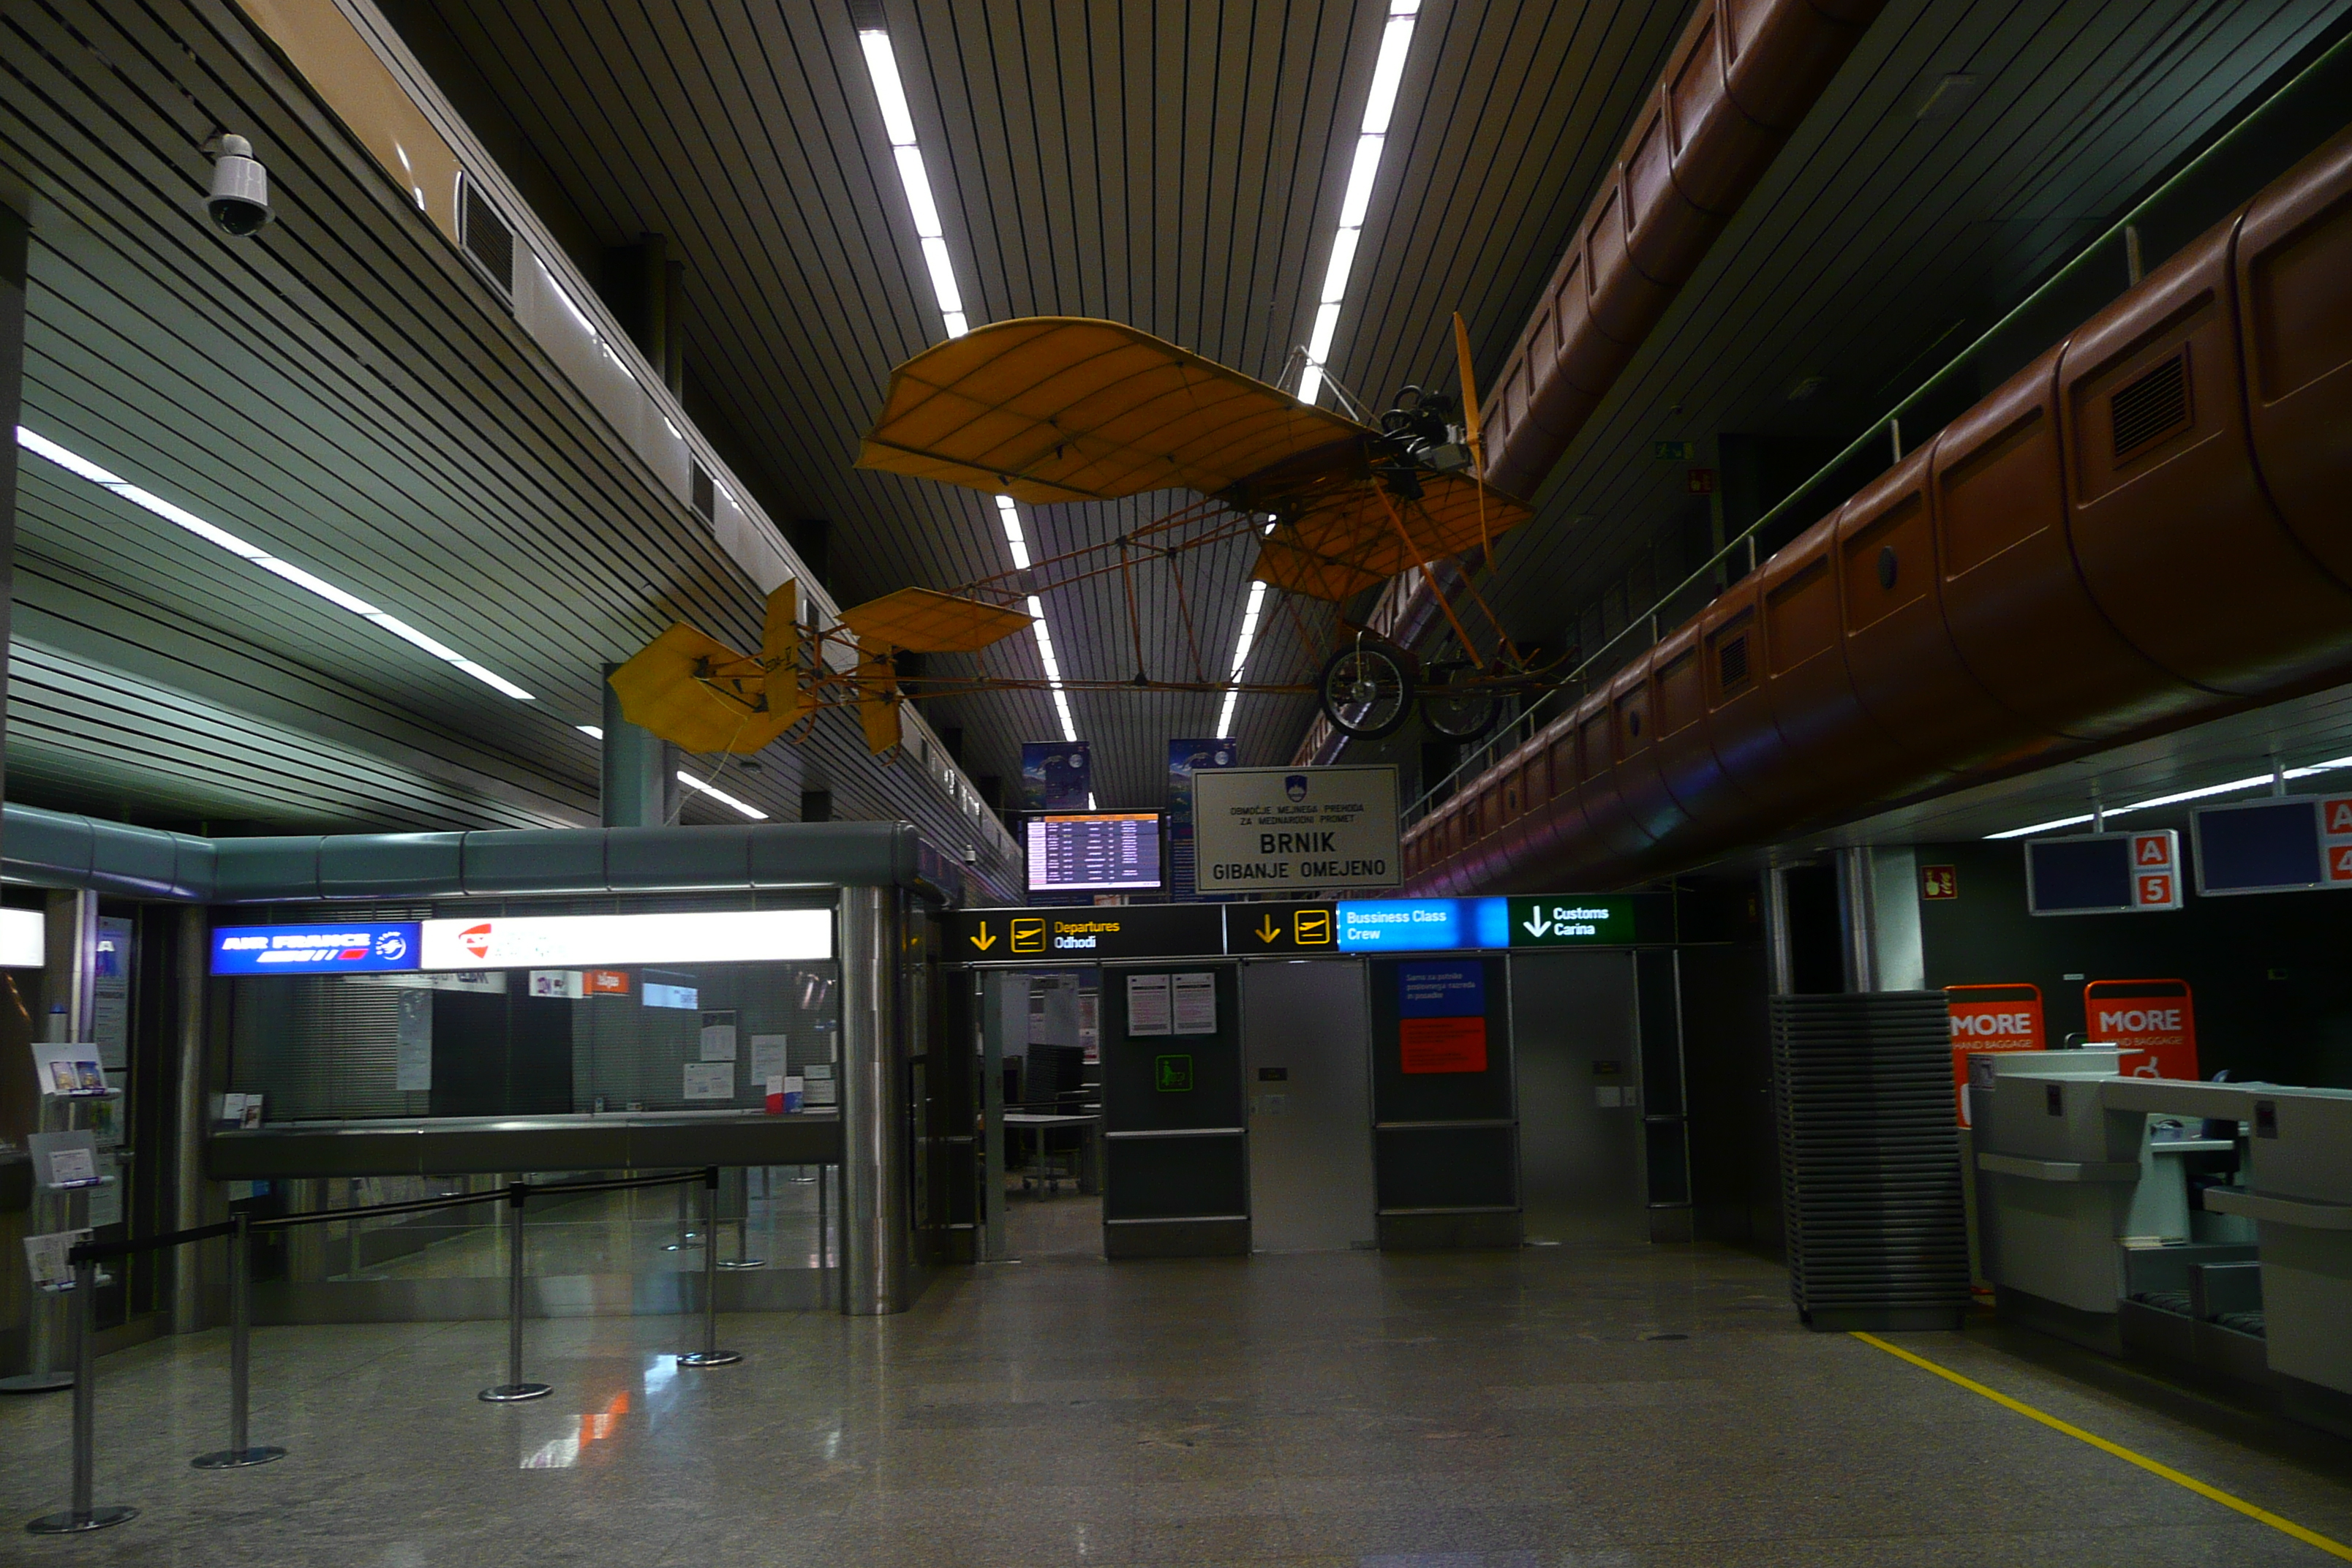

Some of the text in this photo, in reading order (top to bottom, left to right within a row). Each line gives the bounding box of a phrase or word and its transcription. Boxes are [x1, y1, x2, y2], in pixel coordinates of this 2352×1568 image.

[1230, 804, 1364, 815] OBMOČJE MEJNEGA PREHODA
[1240, 814, 1355, 826] ZA MEDNARODNI PROMET
[2332, 804, 2352, 830] A
[1260, 832, 1336, 853] BRNIK
[2141, 840, 2163, 862] A
[1213, 859, 1386, 880] GIBANJE OMEJENO
[2337, 850, 2352, 875] 4
[2146, 878, 2164, 901] 5
[1346, 910, 1447, 924] Bussiness Class
[1553, 907, 1609, 920] Customs
[1055, 921, 1120, 935] Departures
[1347, 927, 1381, 941] Crew
[1554, 923, 1596, 935] Carina
[222, 937, 268, 950] AIR
[272, 933, 371, 949] FRANCE
[1055, 935, 1096, 949] Odhodi
[1950, 1013, 2032, 1036] MORE
[2099, 1009, 2182, 1033] MORE
[1951, 1039, 2032, 1049] HAND BAGGAGE
[2135, 1036, 2183, 1046] BAGGAGE
